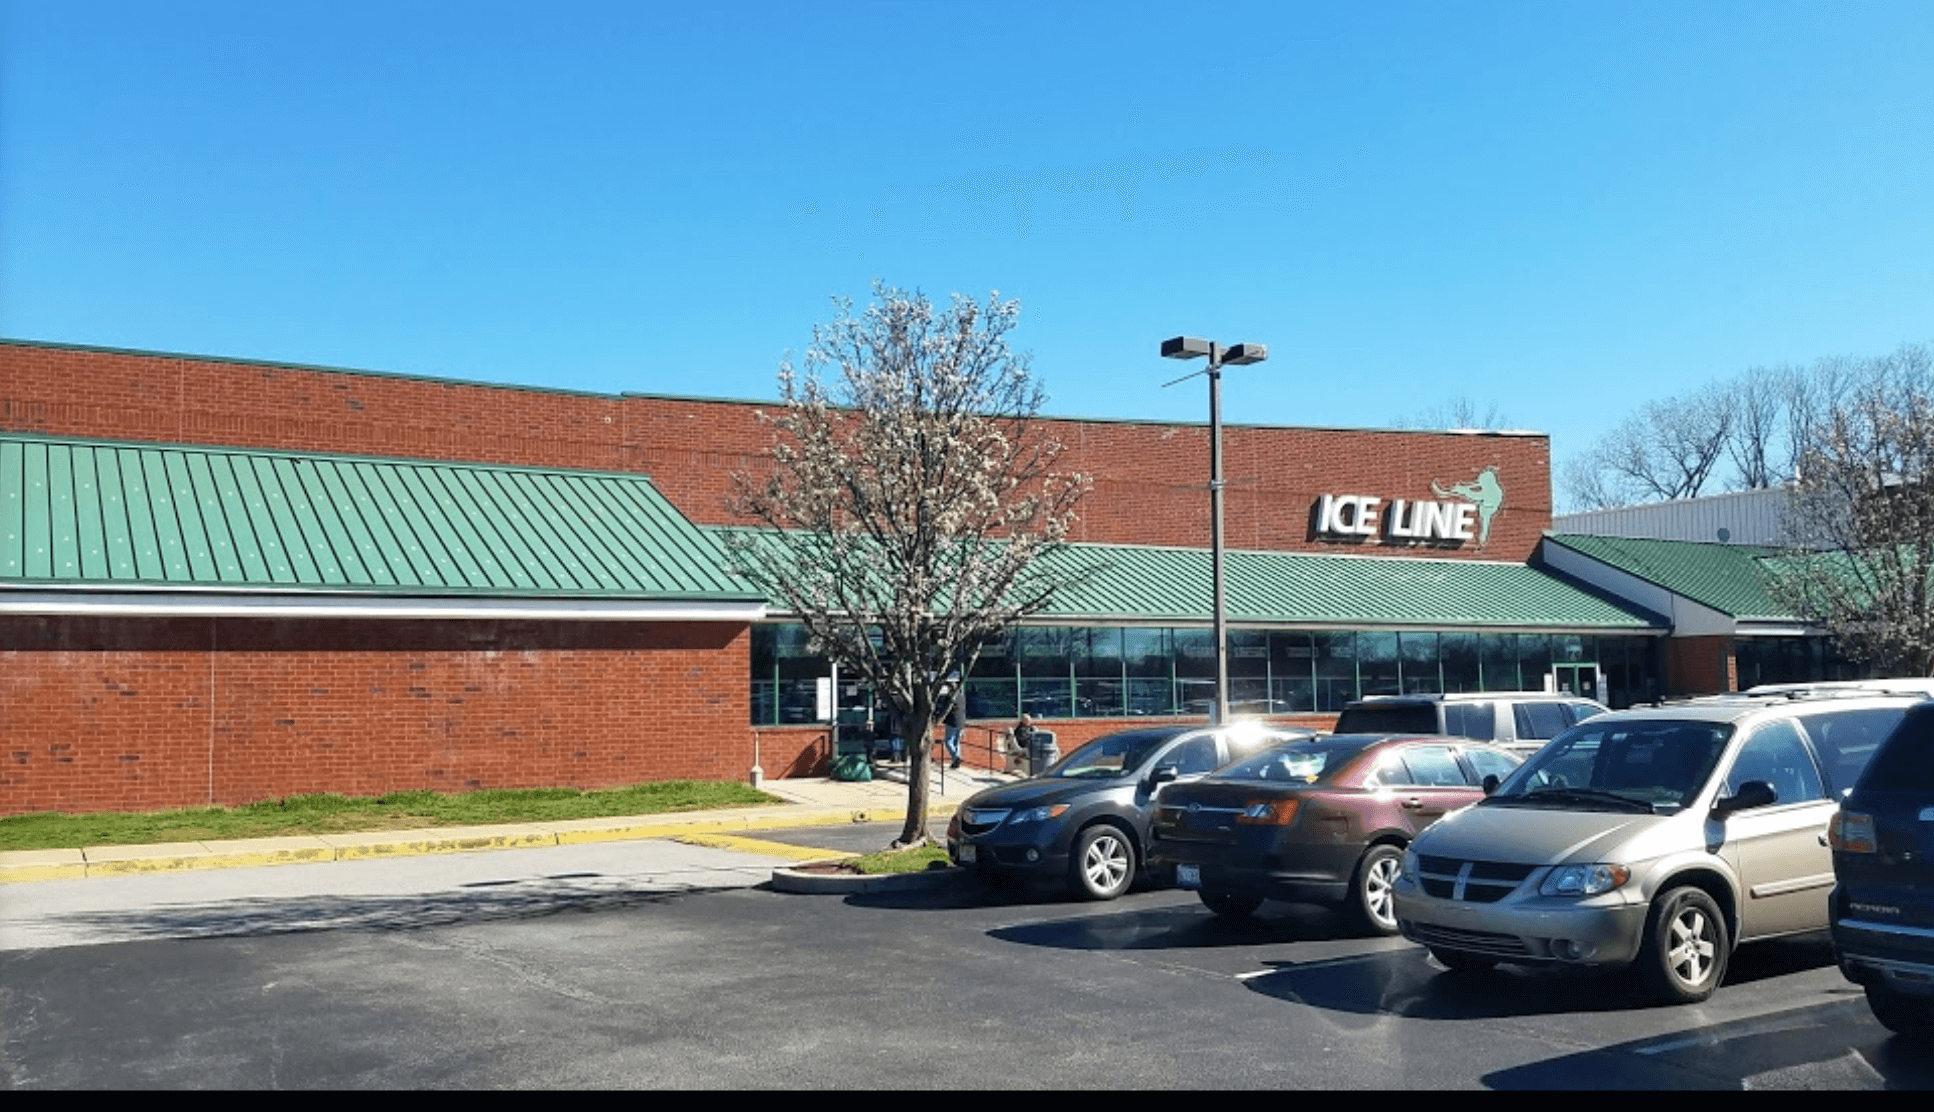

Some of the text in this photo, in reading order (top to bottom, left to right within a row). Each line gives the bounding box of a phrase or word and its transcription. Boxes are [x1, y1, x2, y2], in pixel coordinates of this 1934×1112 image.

[1317, 493, 1476, 539] ICE LINE
[1849, 902, 1900, 914] ACADIA
